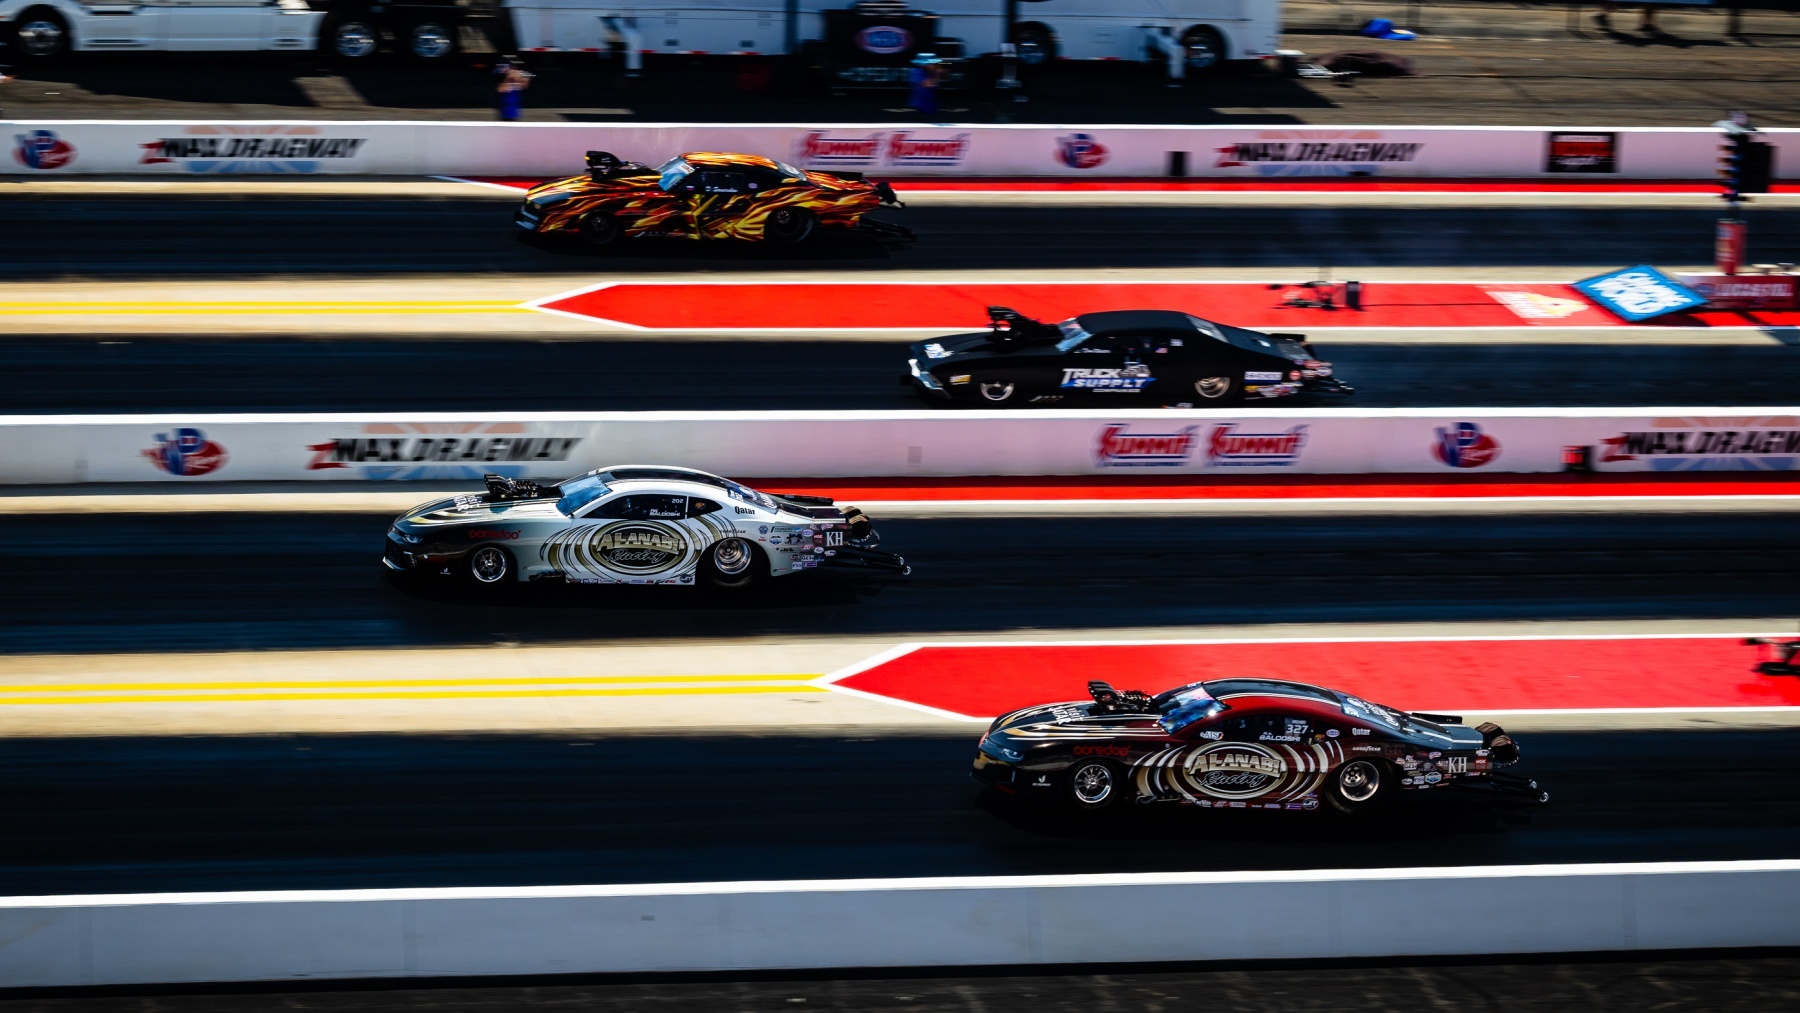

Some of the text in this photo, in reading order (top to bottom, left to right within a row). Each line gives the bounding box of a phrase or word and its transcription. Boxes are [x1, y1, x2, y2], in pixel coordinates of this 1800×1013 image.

[1061, 367, 1124, 386] TRUCK
[1073, 378, 1147, 388] SUPPLY
[411, 437, 582, 462] DRAGWAY
[734, 505, 756, 515] Qatar
[468, 529, 519, 540] ooredoo
[825, 531, 844, 546] KH
[597, 532, 684, 555] ALANABI
[1286, 724, 1309, 734] 327
[1352, 727, 1371, 736] Qatar
[1073, 744, 1128, 757] ooredoo
[1189, 753, 1281, 778] ALANABI
[1447, 757, 1468, 774] KH
